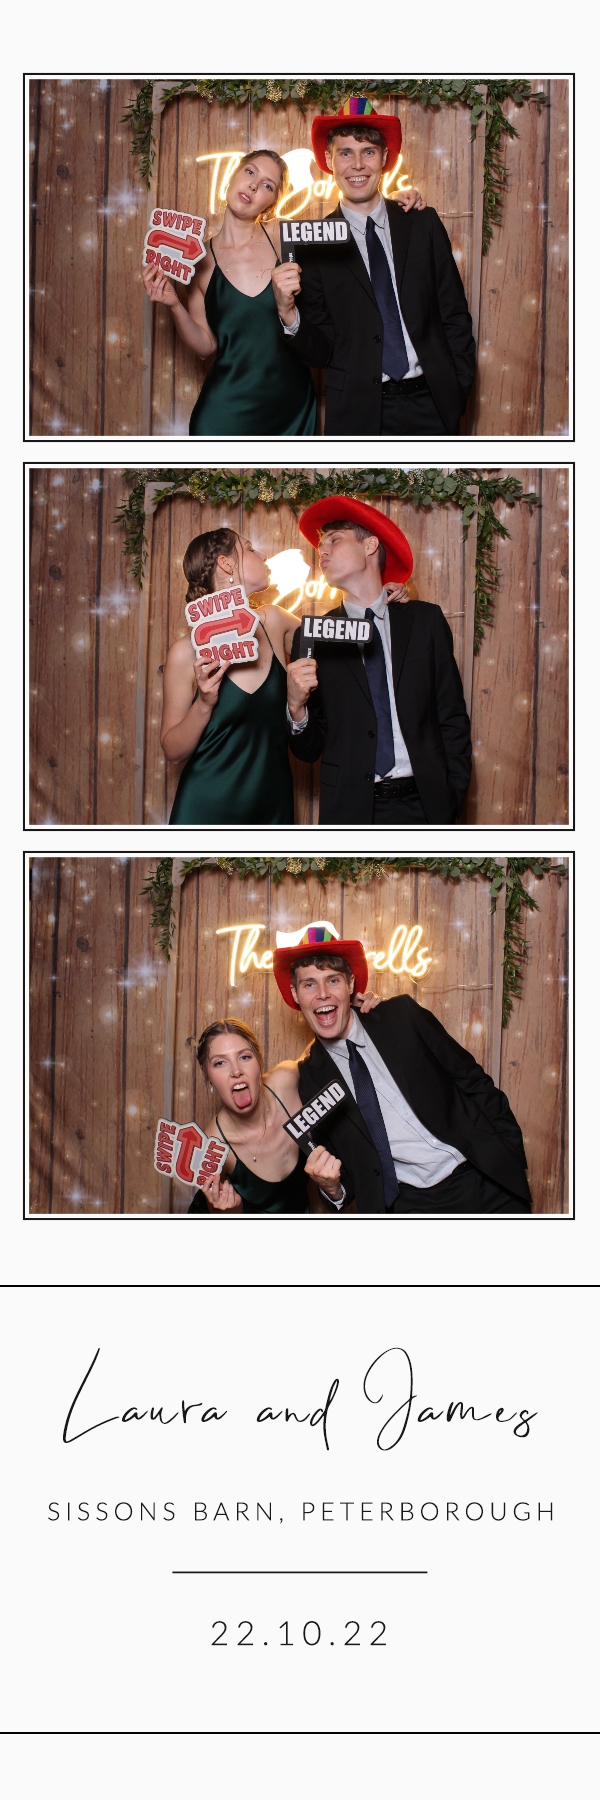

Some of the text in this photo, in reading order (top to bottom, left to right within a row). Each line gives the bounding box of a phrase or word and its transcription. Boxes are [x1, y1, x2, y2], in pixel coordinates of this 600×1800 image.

[196, 151, 247, 214] Th
[152, 210, 204, 236] SWIPE
[282, 221, 348, 242] LEGEND
[145, 249, 192, 281] RIGHT
[188, 587, 245, 622] SWIPE
[303, 618, 371, 641] LEGEND
[199, 641, 255, 663] RIGHT
[216, 923, 273, 987] The
[286, 1082, 346, 1139] LEGEND
[156, 1121, 177, 1174] SWIPE
[196, 1141, 226, 1188] RIGHT
